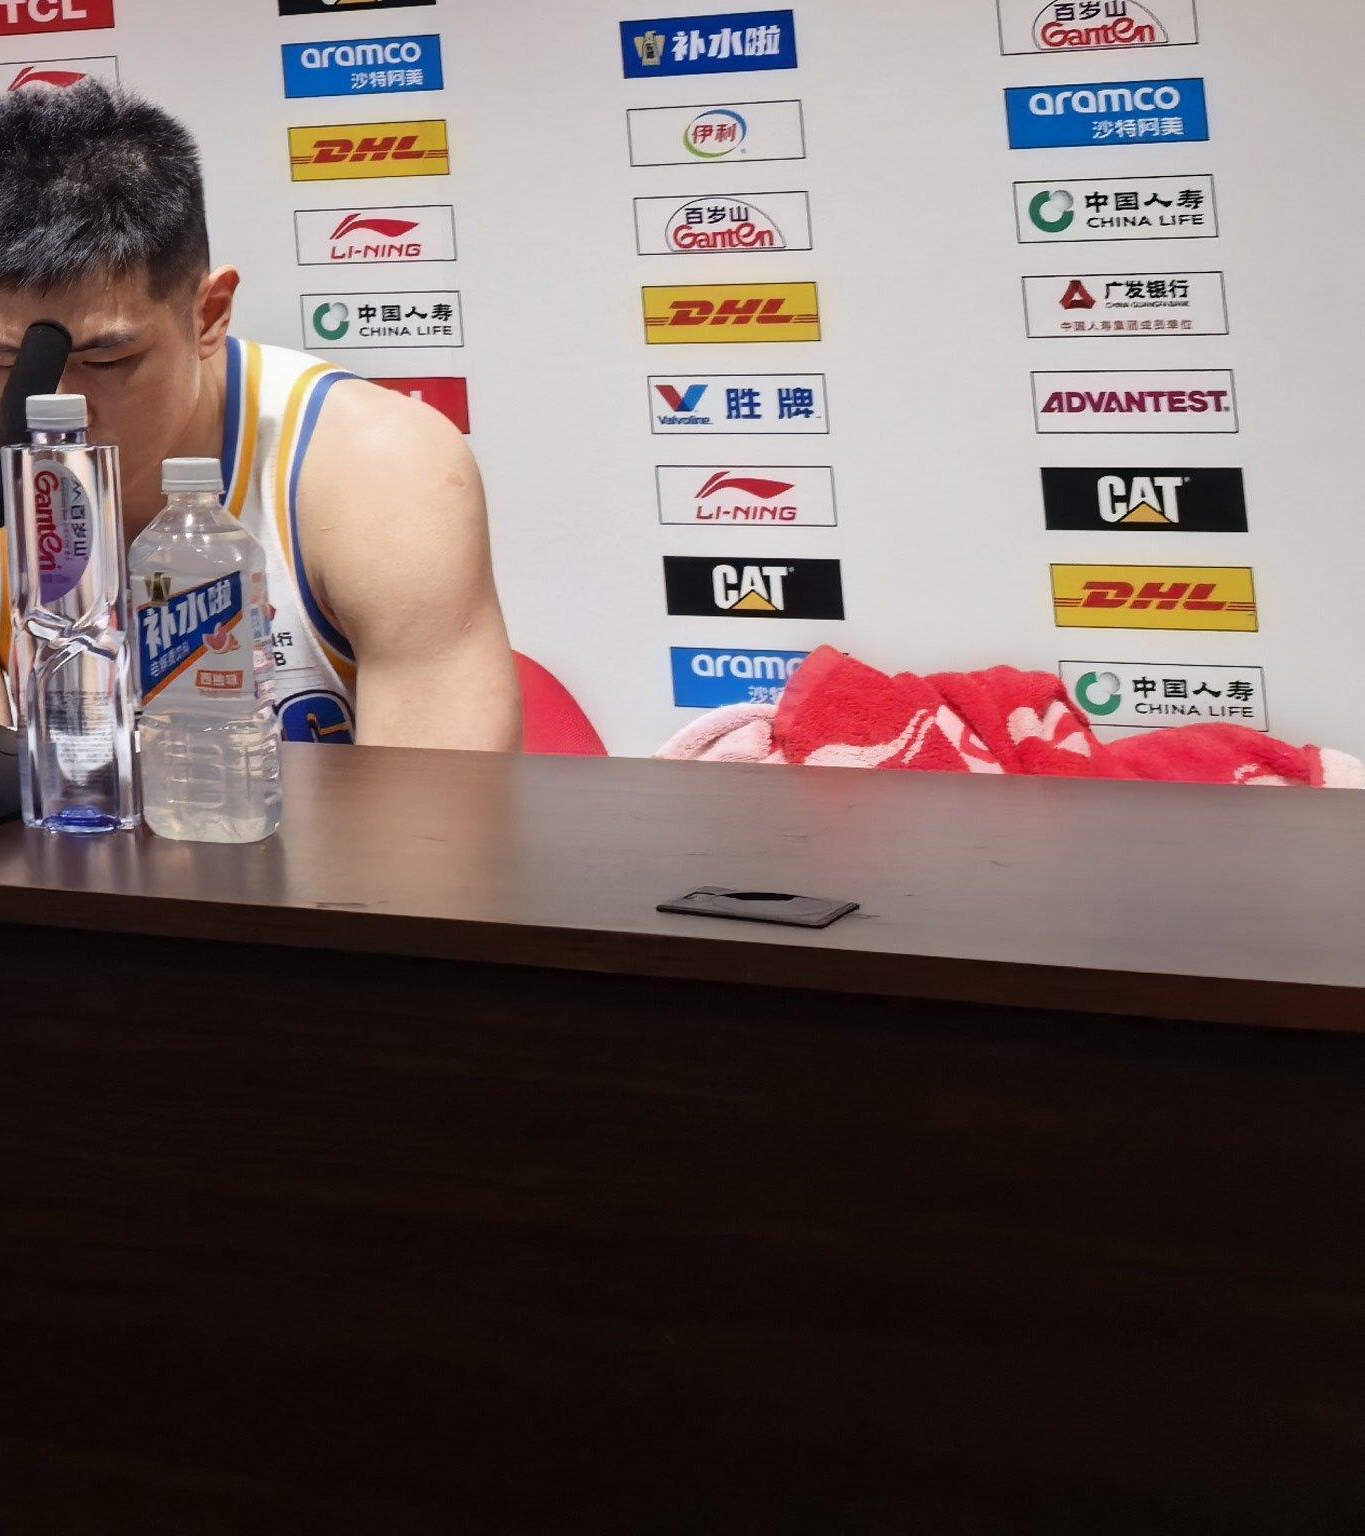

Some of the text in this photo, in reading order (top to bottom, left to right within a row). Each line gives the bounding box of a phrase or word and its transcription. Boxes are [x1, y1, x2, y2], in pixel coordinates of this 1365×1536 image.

[301, 42, 421, 68] aramco
[671, 25, 780, 61] 补水啦
[351, 69, 423, 89] 沙特阿美
[1029, 86, 1180, 115] aramco
[691, 123, 737, 147] 伊利
[1092, 117, 1184, 138] 沙特阿美
[311, 136, 427, 164] DHL
[1085, 190, 1204, 213] 中国人寿
[681, 206, 749, 225] 百岁山
[1087, 214, 1204, 228] CHINA LIFE
[331, 244, 421, 259] LI-NING
[1105, 280, 1189, 299] 广发银行
[358, 304, 452, 323] 中国人寿
[667, 298, 795, 326] DHL
[359, 326, 453, 336] CHINA LIFE
[726, 388, 814, 419] 胜牌
[1041, 390, 1227, 412] ADVANTEST
[1097, 476, 1183, 523] CAT
[696, 506, 797, 520] LI-NING
[712, 565, 787, 610] CAT
[1080, 582, 1226, 611] DHL
[143, 579, 232, 660] 补水啦
[691, 653, 805, 680] aram
[1132, 676, 1253, 701] 中国人寿
[1135, 703, 1254, 717] CHINA LIFE
